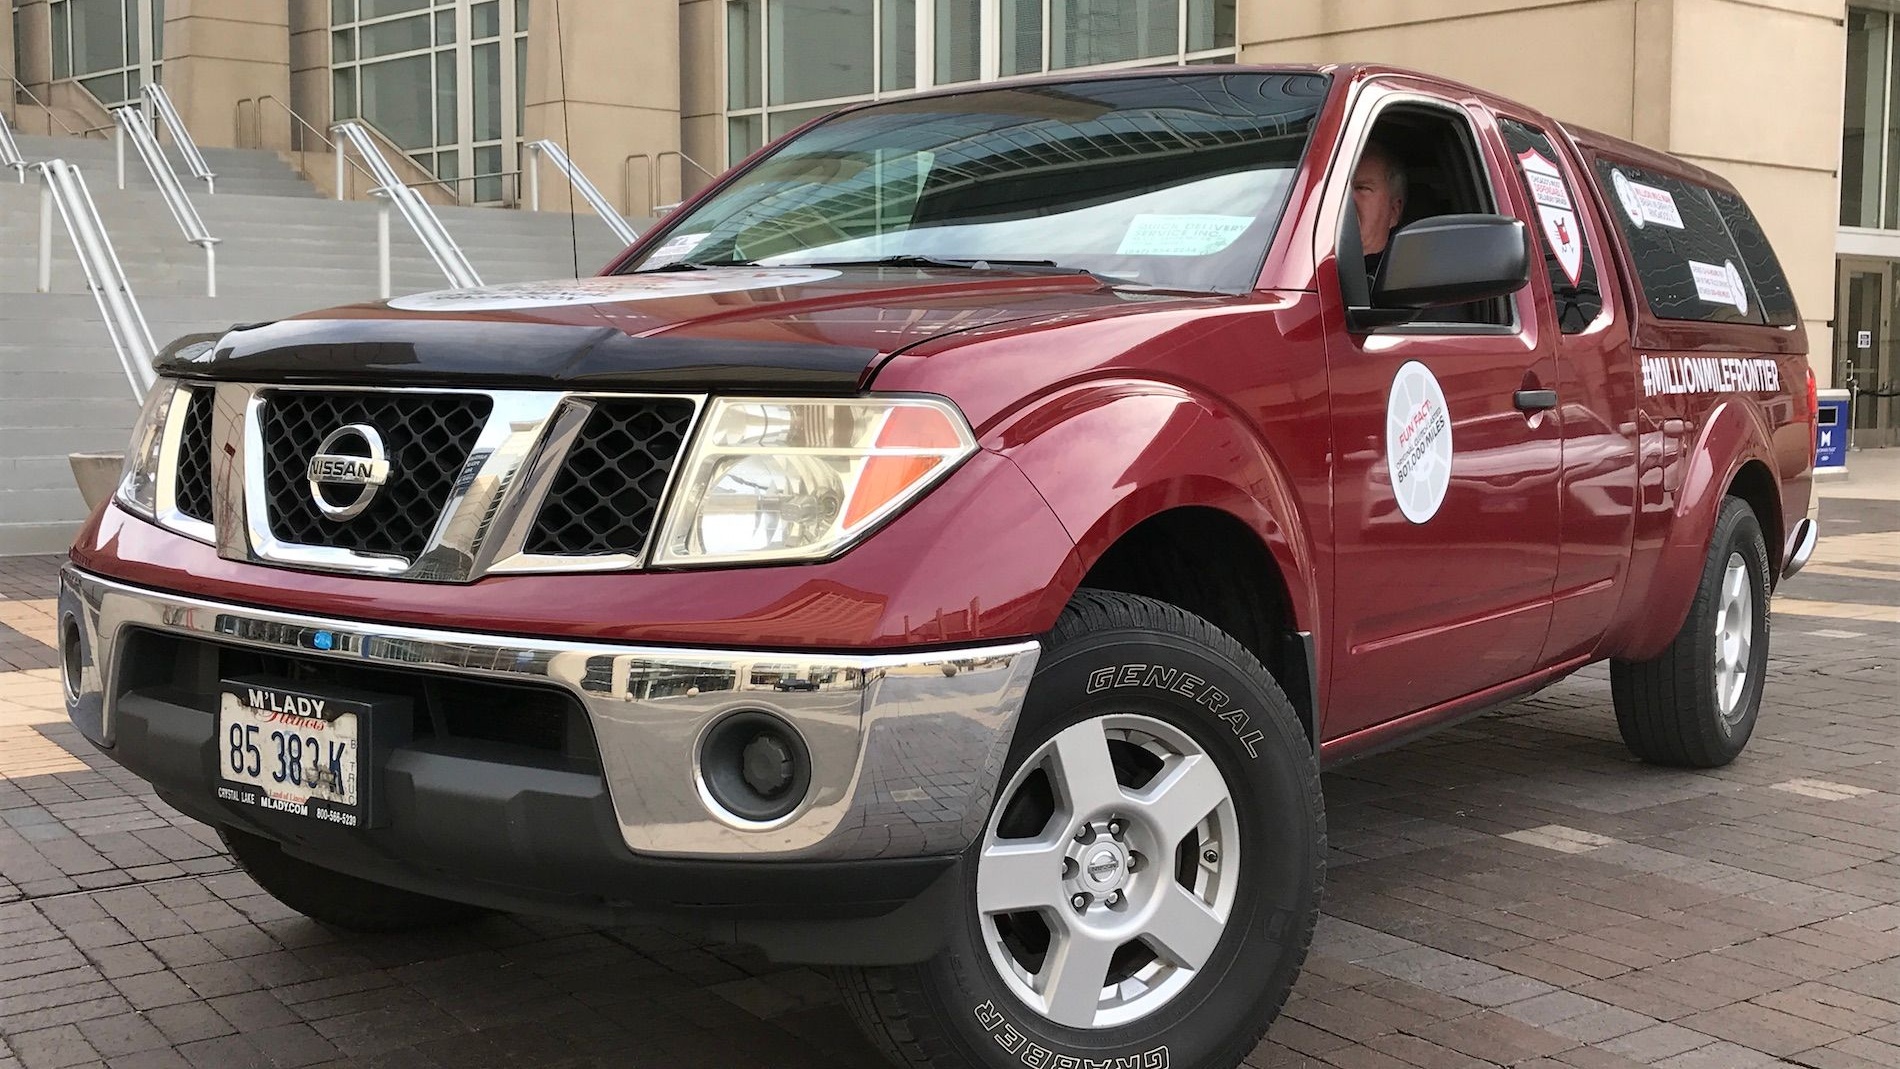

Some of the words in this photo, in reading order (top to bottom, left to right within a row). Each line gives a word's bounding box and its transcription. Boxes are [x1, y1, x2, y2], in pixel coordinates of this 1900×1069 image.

[1641, 354, 1780, 397] #MILLIONMILEFRONTIER
[1399, 421, 1415, 448] FUN
[1413, 399, 1432, 428] FACT:
[310, 460, 373, 478] NISSAN
[1397, 442, 1426, 484] 801,000
[1425, 415, 1446, 447] MILES
[1086, 663, 1265, 760] GENERAL
[229, 723, 261, 778] 85
[217, 787, 239, 803] CRYSTAL
[241, 791, 256, 805] LAKE
[260, 796, 308, 817] MLADY.COM
